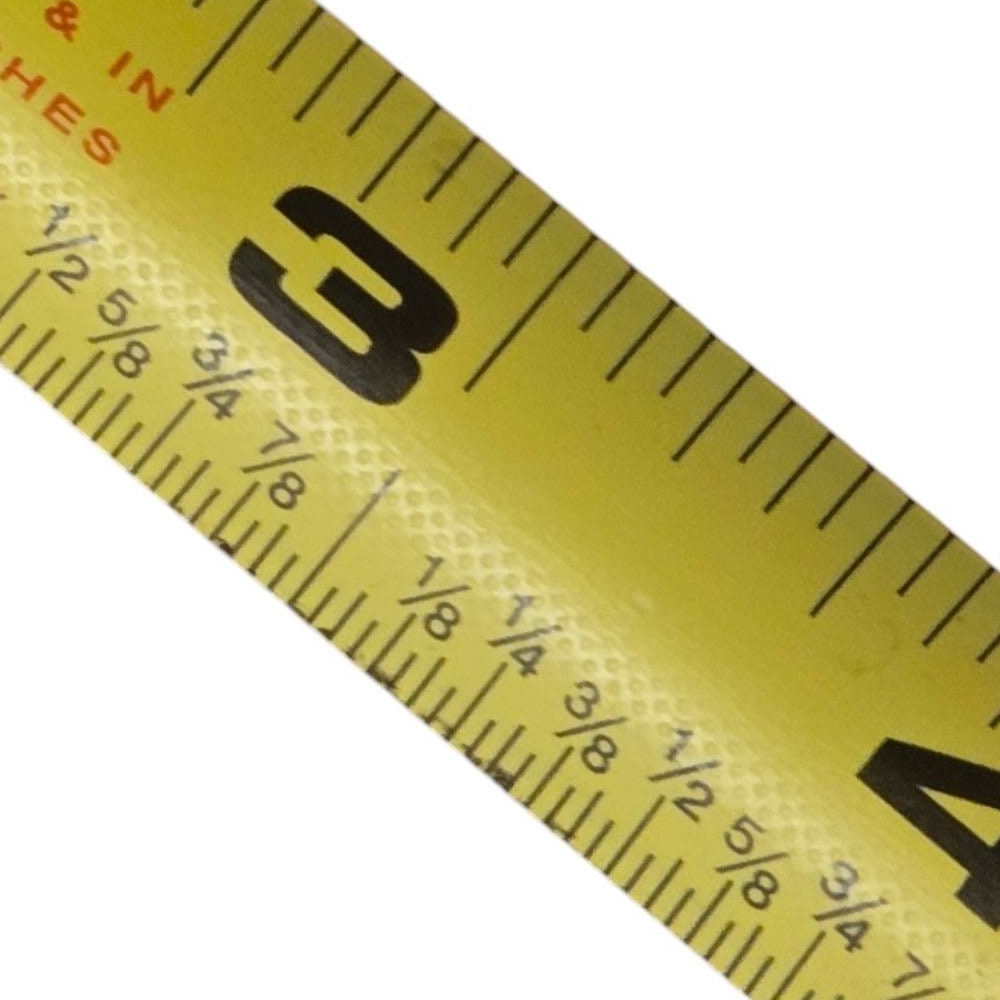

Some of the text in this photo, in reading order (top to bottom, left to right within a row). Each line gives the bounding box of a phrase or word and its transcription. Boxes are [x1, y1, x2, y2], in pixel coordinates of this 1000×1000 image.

[44, 2, 79, 41] &
[109, 53, 174, 113] IN
[27, 206, 97, 293] 1/2
[89, 290, 160, 378] 5/8
[229, 186, 458, 406] 3
[185, 334, 254, 421] 3/4
[242, 422, 315, 510] 7/8
[399, 557, 469, 641] 1/8
[489, 594, 560, 677] 1/4
[556, 682, 626, 775] 3/8
[649, 730, 719, 819] 1/2
[715, 814, 789, 910] 5/8
[855, 736, 1000, 932] 4
[812, 860, 888, 953] 3/4
